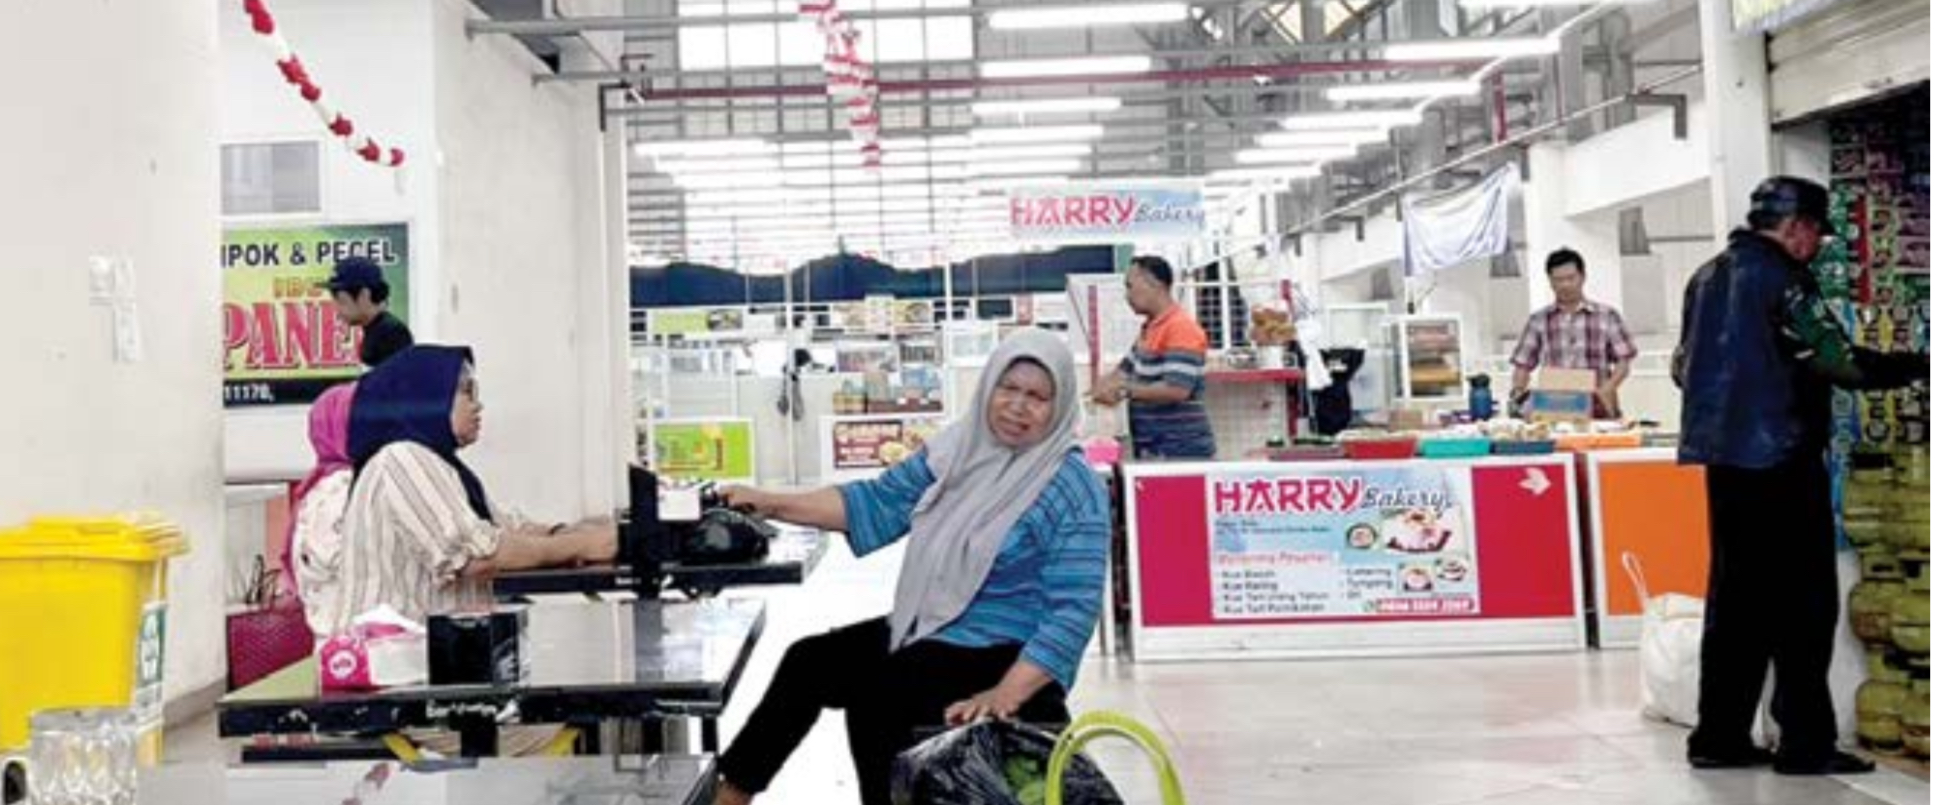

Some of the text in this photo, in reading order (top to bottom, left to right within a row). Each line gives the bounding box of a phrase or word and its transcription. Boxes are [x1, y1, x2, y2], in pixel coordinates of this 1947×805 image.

[1010, 195, 1206, 227] HARRY Bakery
[290, 242, 306, 265] &
[317, 241, 396, 263] PECEL
[1214, 479, 1360, 513] HARRY
